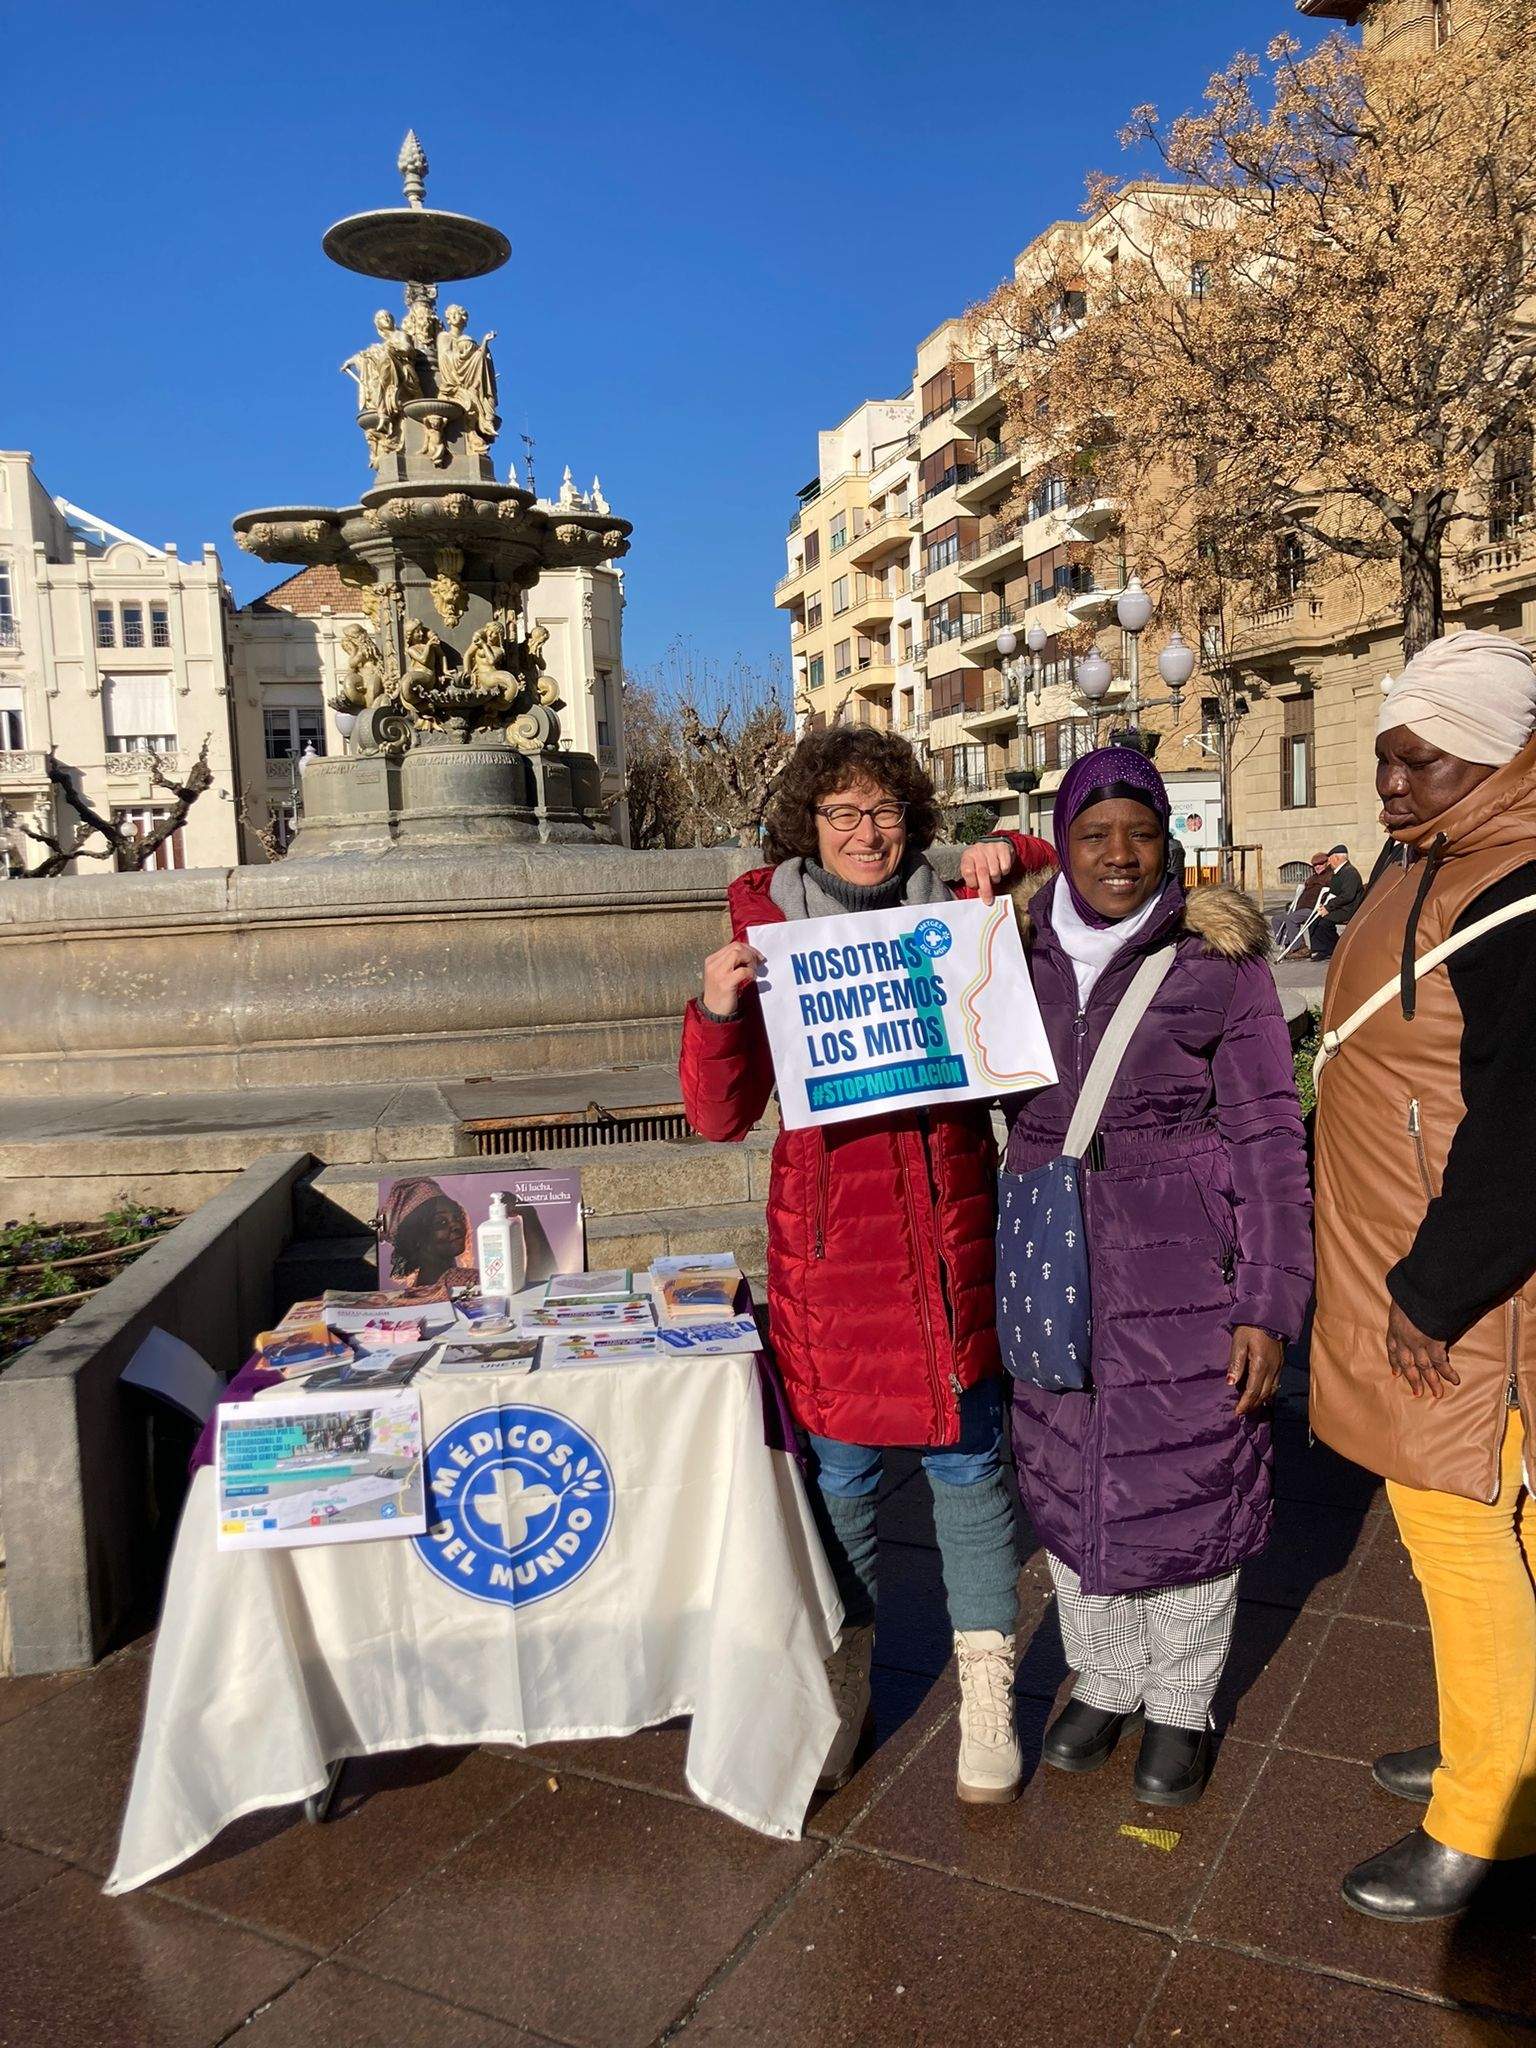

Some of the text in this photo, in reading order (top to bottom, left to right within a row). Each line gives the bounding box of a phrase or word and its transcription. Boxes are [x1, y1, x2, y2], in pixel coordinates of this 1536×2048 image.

[790, 936, 924, 985] NOSOTRAS
[799, 974, 948, 1026] ROMPEMOS
[806, 1015, 944, 1068] LOS MITOS
[812, 1058, 962, 1106] #STOPMUTILACIÓN
[515, 1183, 528, 1192] Mi
[516, 1191, 571, 1202] Nuestra lucha
[432, 1424, 574, 1498] MÉDICOS
[429, 1507, 593, 1591] DEL MUNDO
